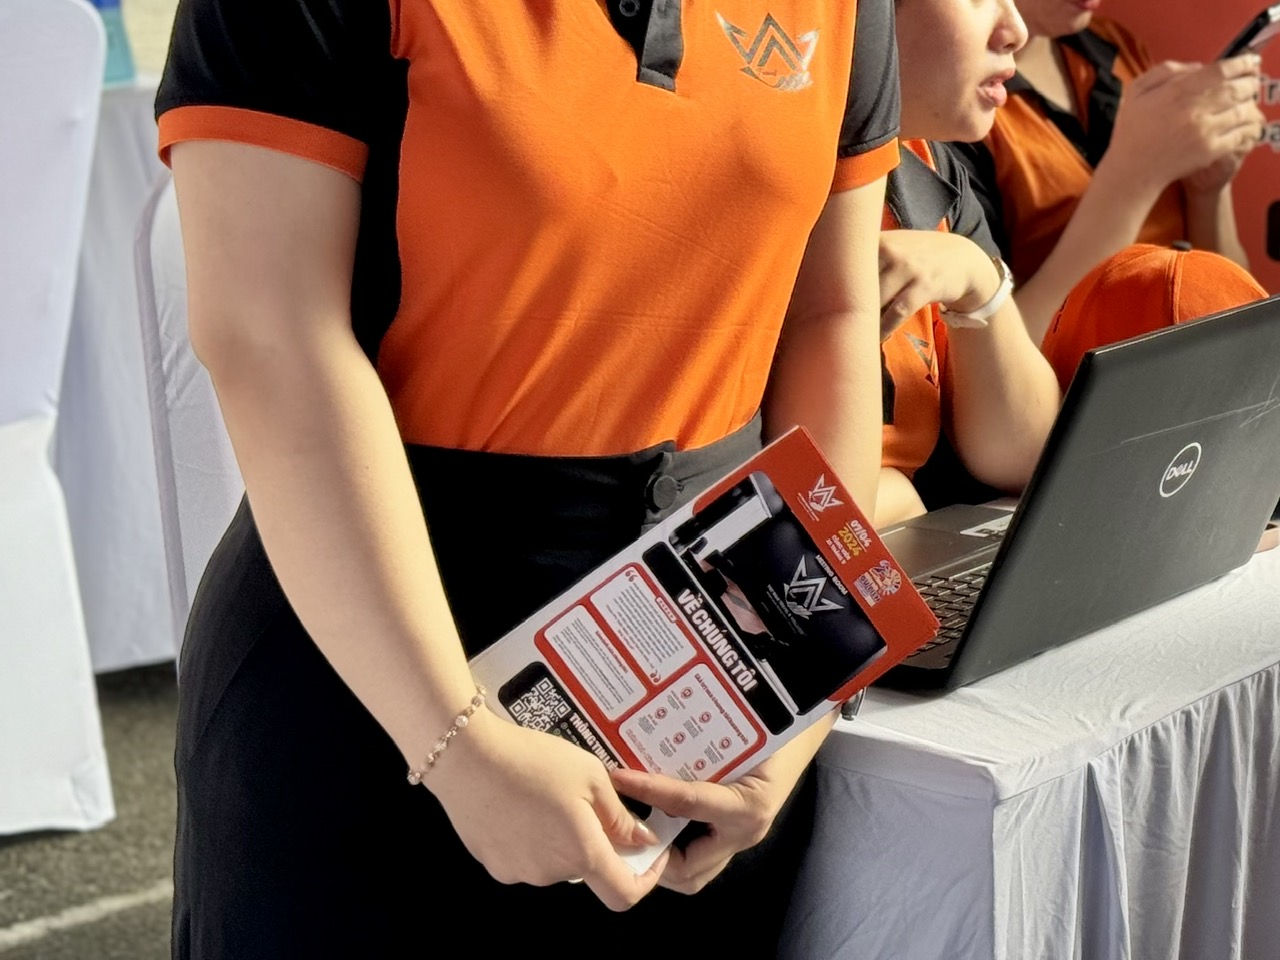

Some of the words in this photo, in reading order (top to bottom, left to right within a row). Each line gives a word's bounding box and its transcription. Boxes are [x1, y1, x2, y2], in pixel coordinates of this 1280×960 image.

[1166, 460, 1193, 480] DELL
[838, 526, 862, 557] 2024
[850, 520, 872, 548] 07/04
[678, 588, 703, 615] VỀ
[692, 609, 739, 668] CHÚNG
[730, 659, 758, 692] TÔI
[570, 713, 595, 747] THÔNG
[591, 741, 609, 763] TIN
[604, 757, 619, 772] LIÊ
